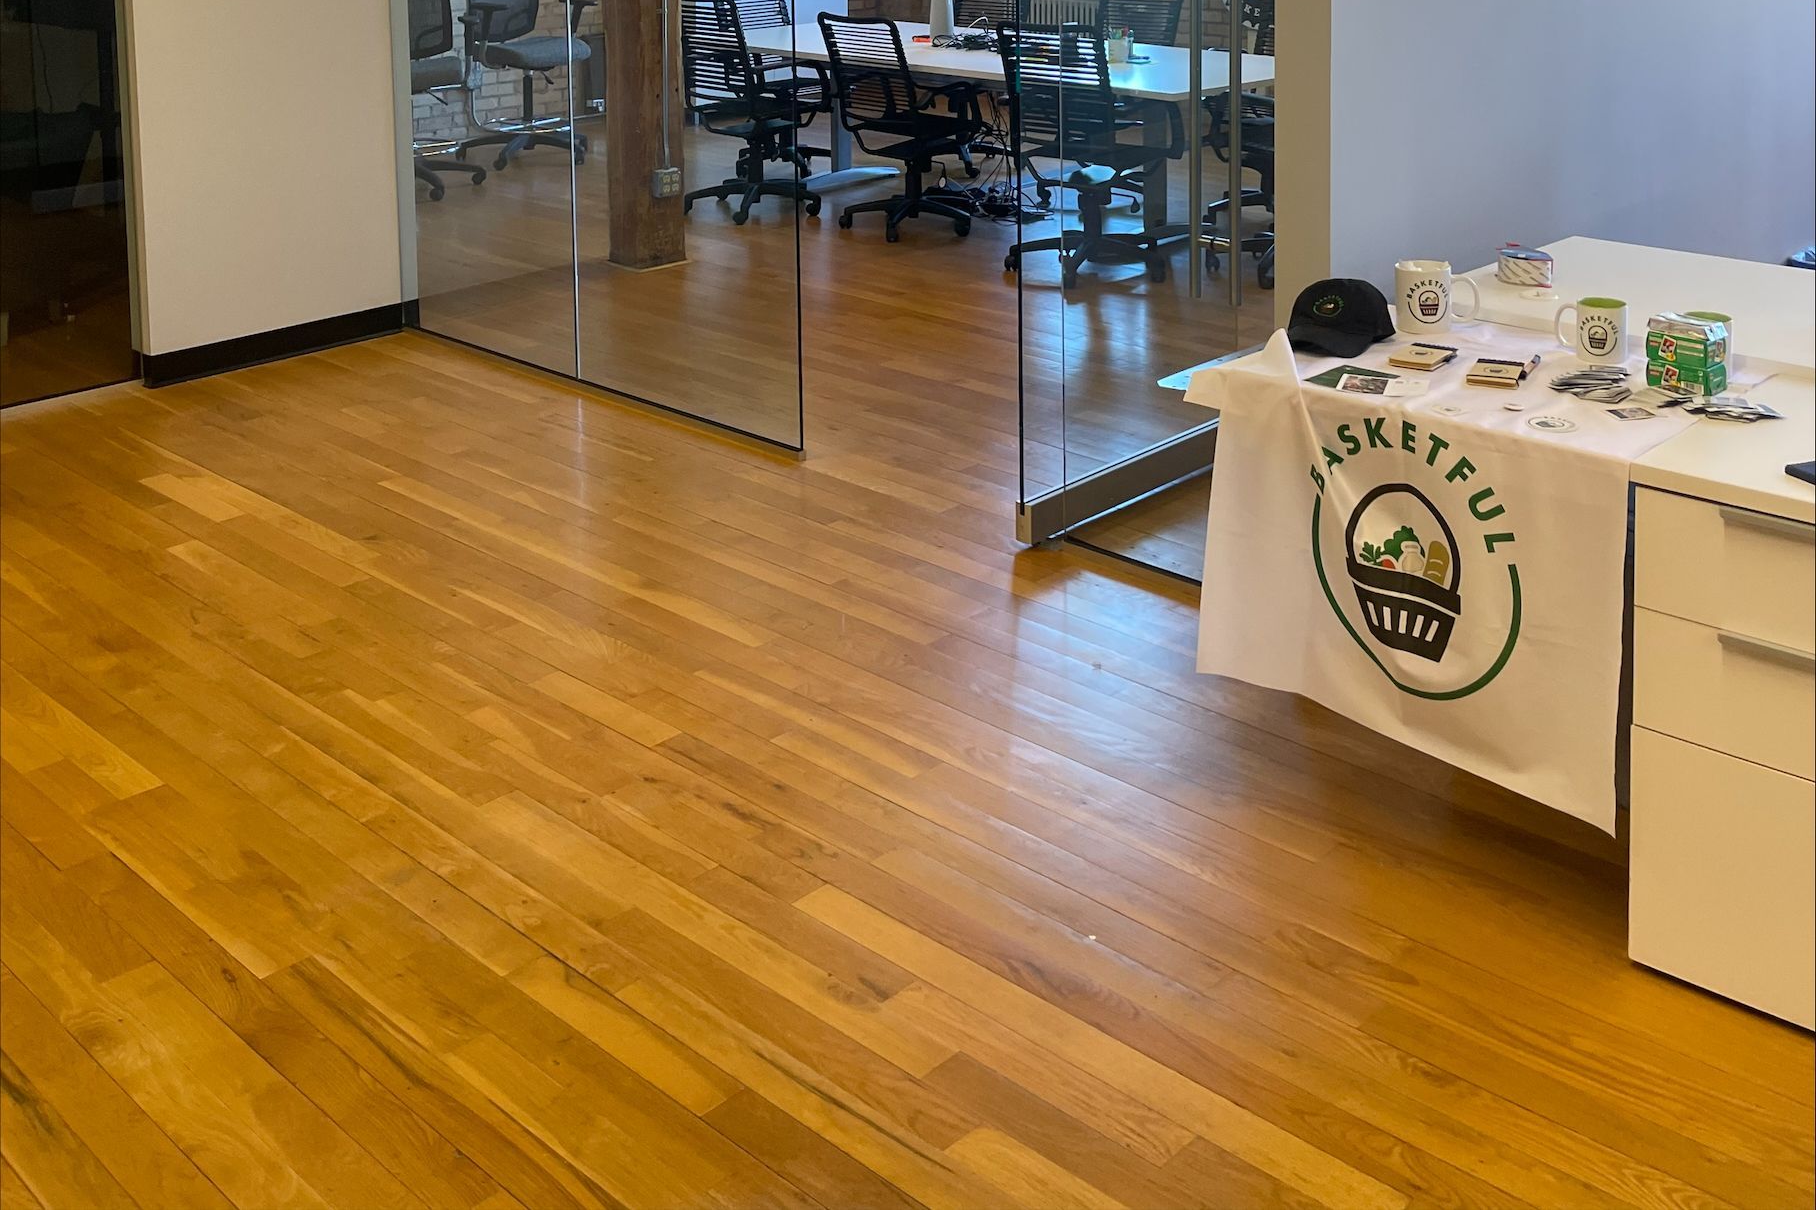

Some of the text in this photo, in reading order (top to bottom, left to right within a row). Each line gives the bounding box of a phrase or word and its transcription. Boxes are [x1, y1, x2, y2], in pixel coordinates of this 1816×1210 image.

[1406, 279, 1448, 299] BASKETFUL
[1580, 315, 1619, 335] BASKETFUL
[1310, 417, 1516, 553] BASKETFUL
